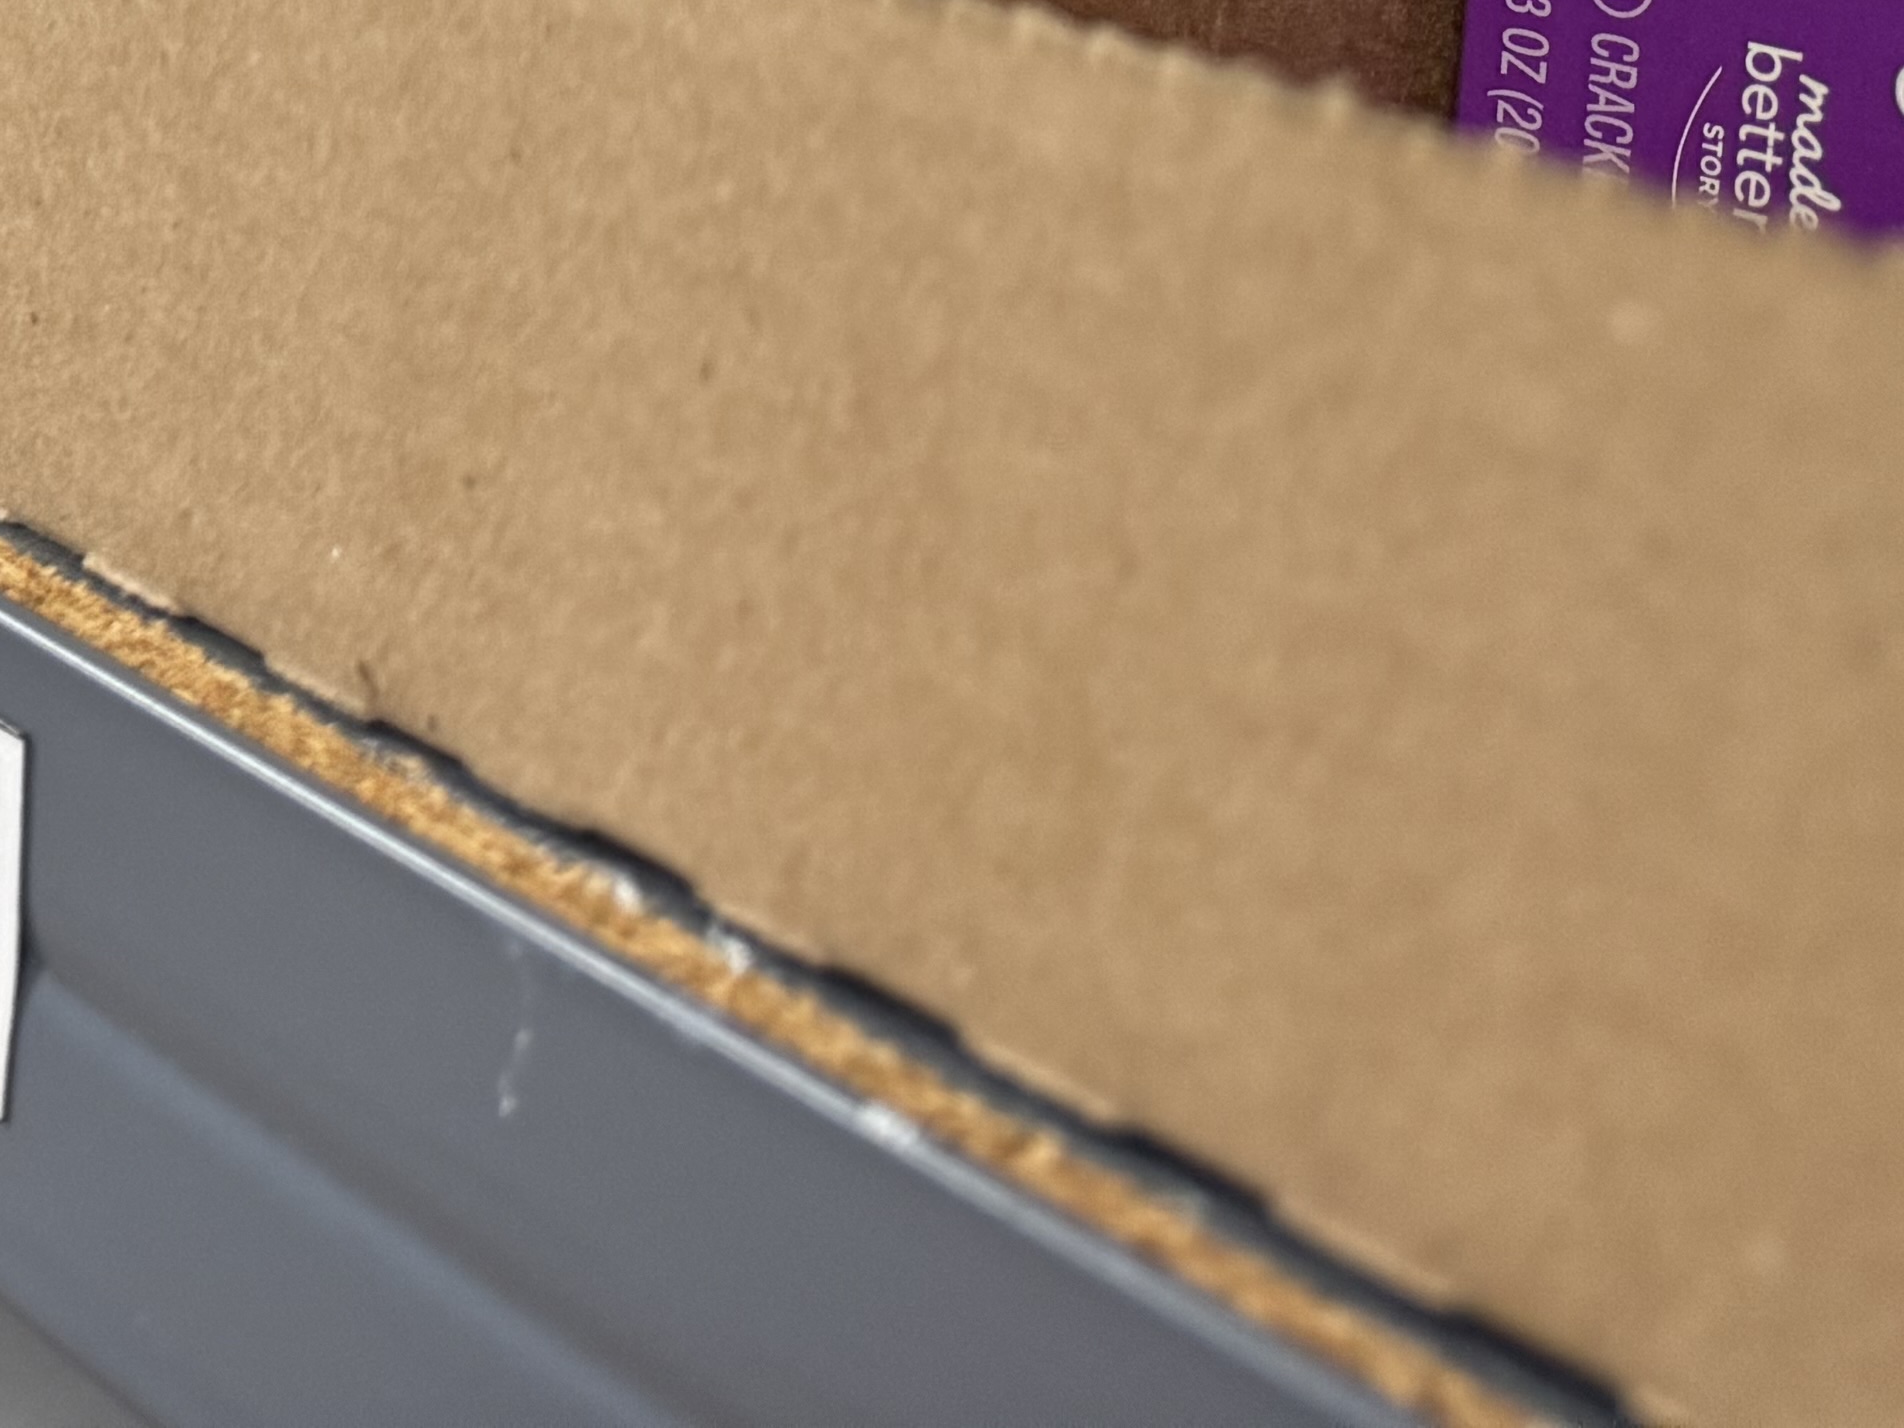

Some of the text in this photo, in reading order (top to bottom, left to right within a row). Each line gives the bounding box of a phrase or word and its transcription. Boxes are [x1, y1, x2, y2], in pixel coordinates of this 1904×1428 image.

[1500, 27, 1550, 84] OZ
[1733, 41, 1803, 233] better
[1788, 73, 1842, 231] made
